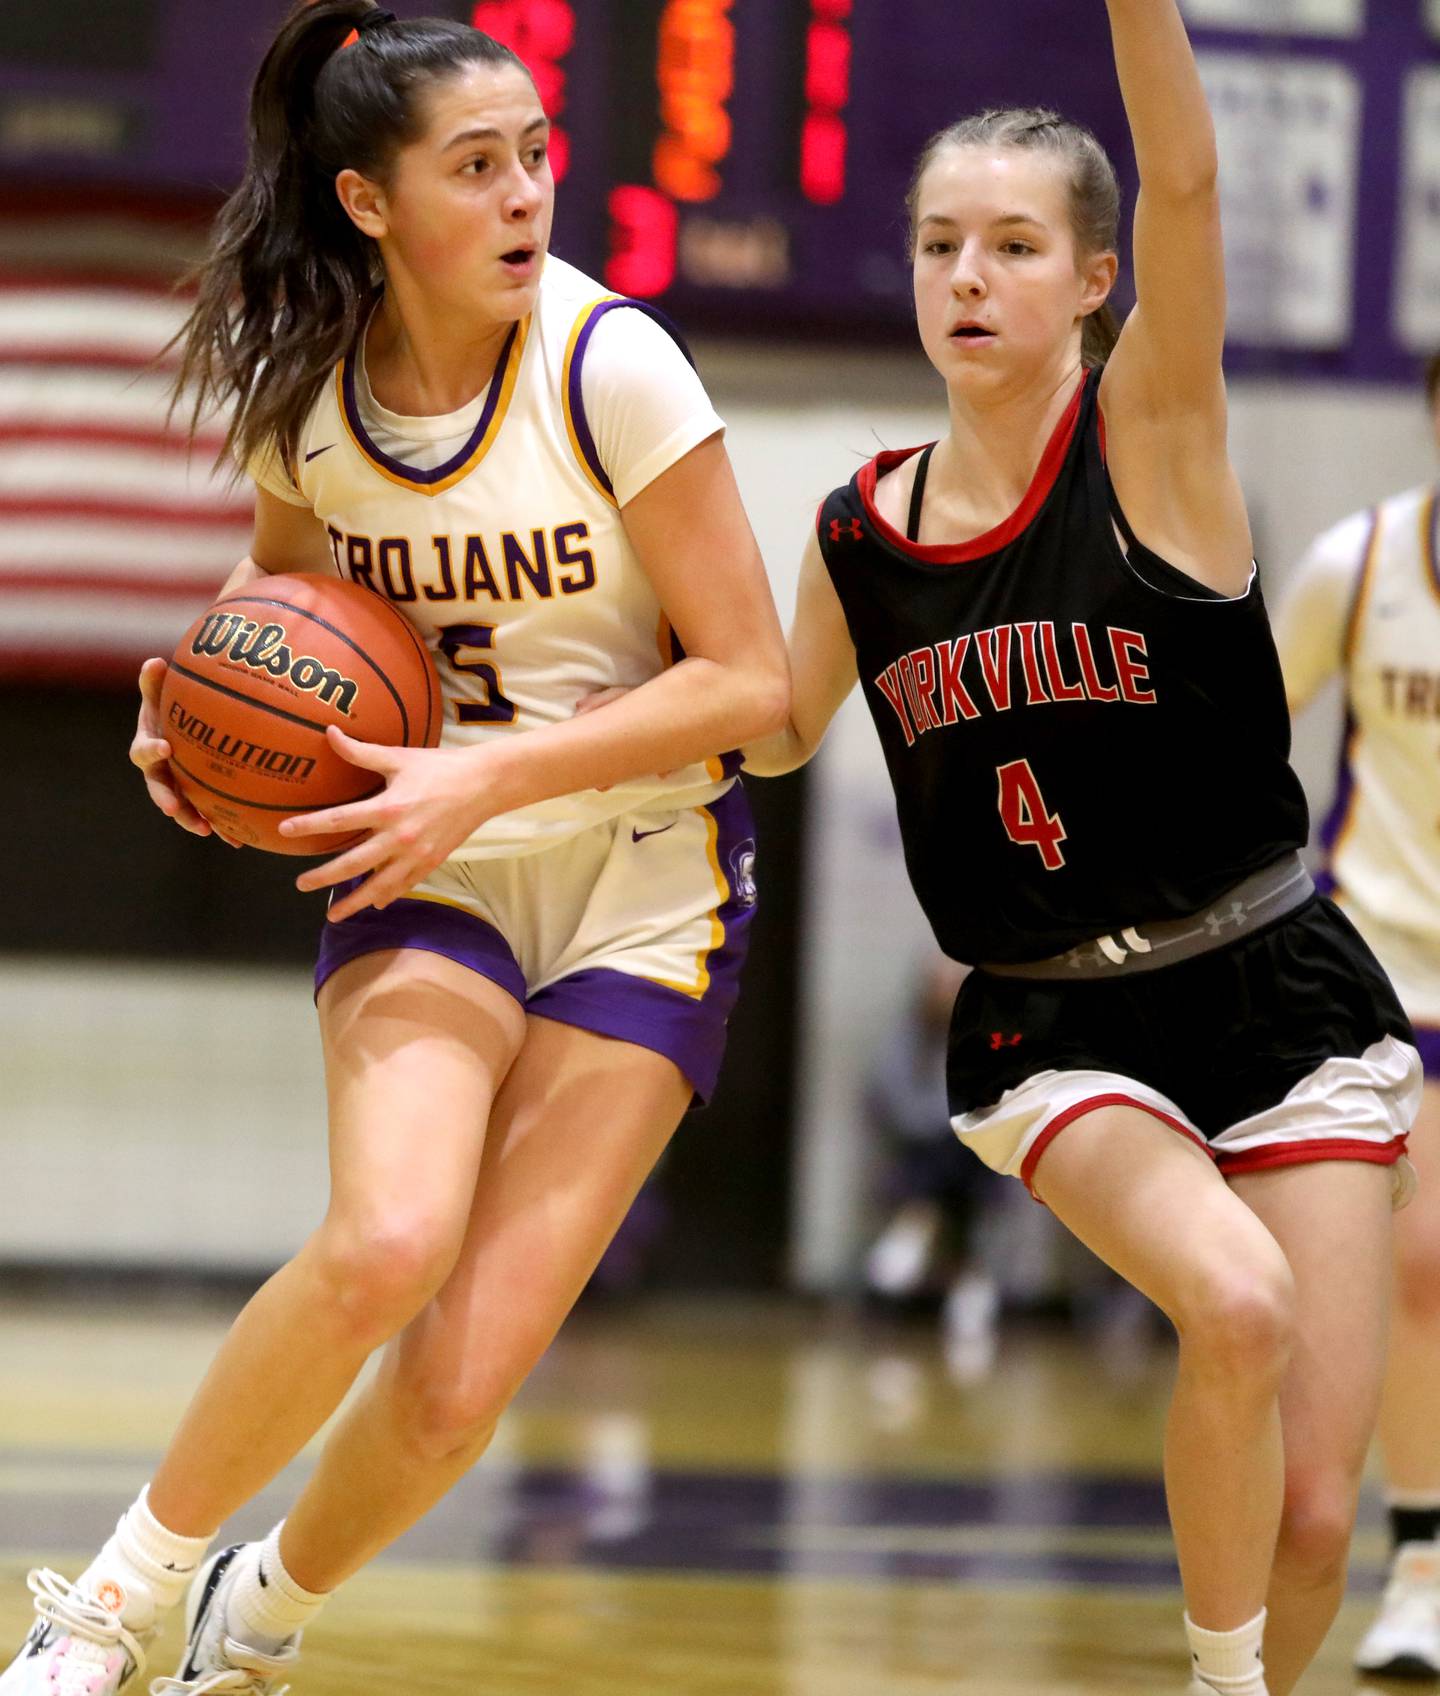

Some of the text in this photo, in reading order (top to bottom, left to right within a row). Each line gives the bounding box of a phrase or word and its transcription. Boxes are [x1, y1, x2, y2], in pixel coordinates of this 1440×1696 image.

[326, 519, 597, 602] TROJANS
[191, 613, 358, 716] Wilson
[434, 621, 519, 726] 5
[874, 621, 1157, 747] YORKVILLE
[1380, 666, 1440, 718] TR
[169, 701, 316, 779] EVOLUTION
[996, 758, 1068, 870] 4
